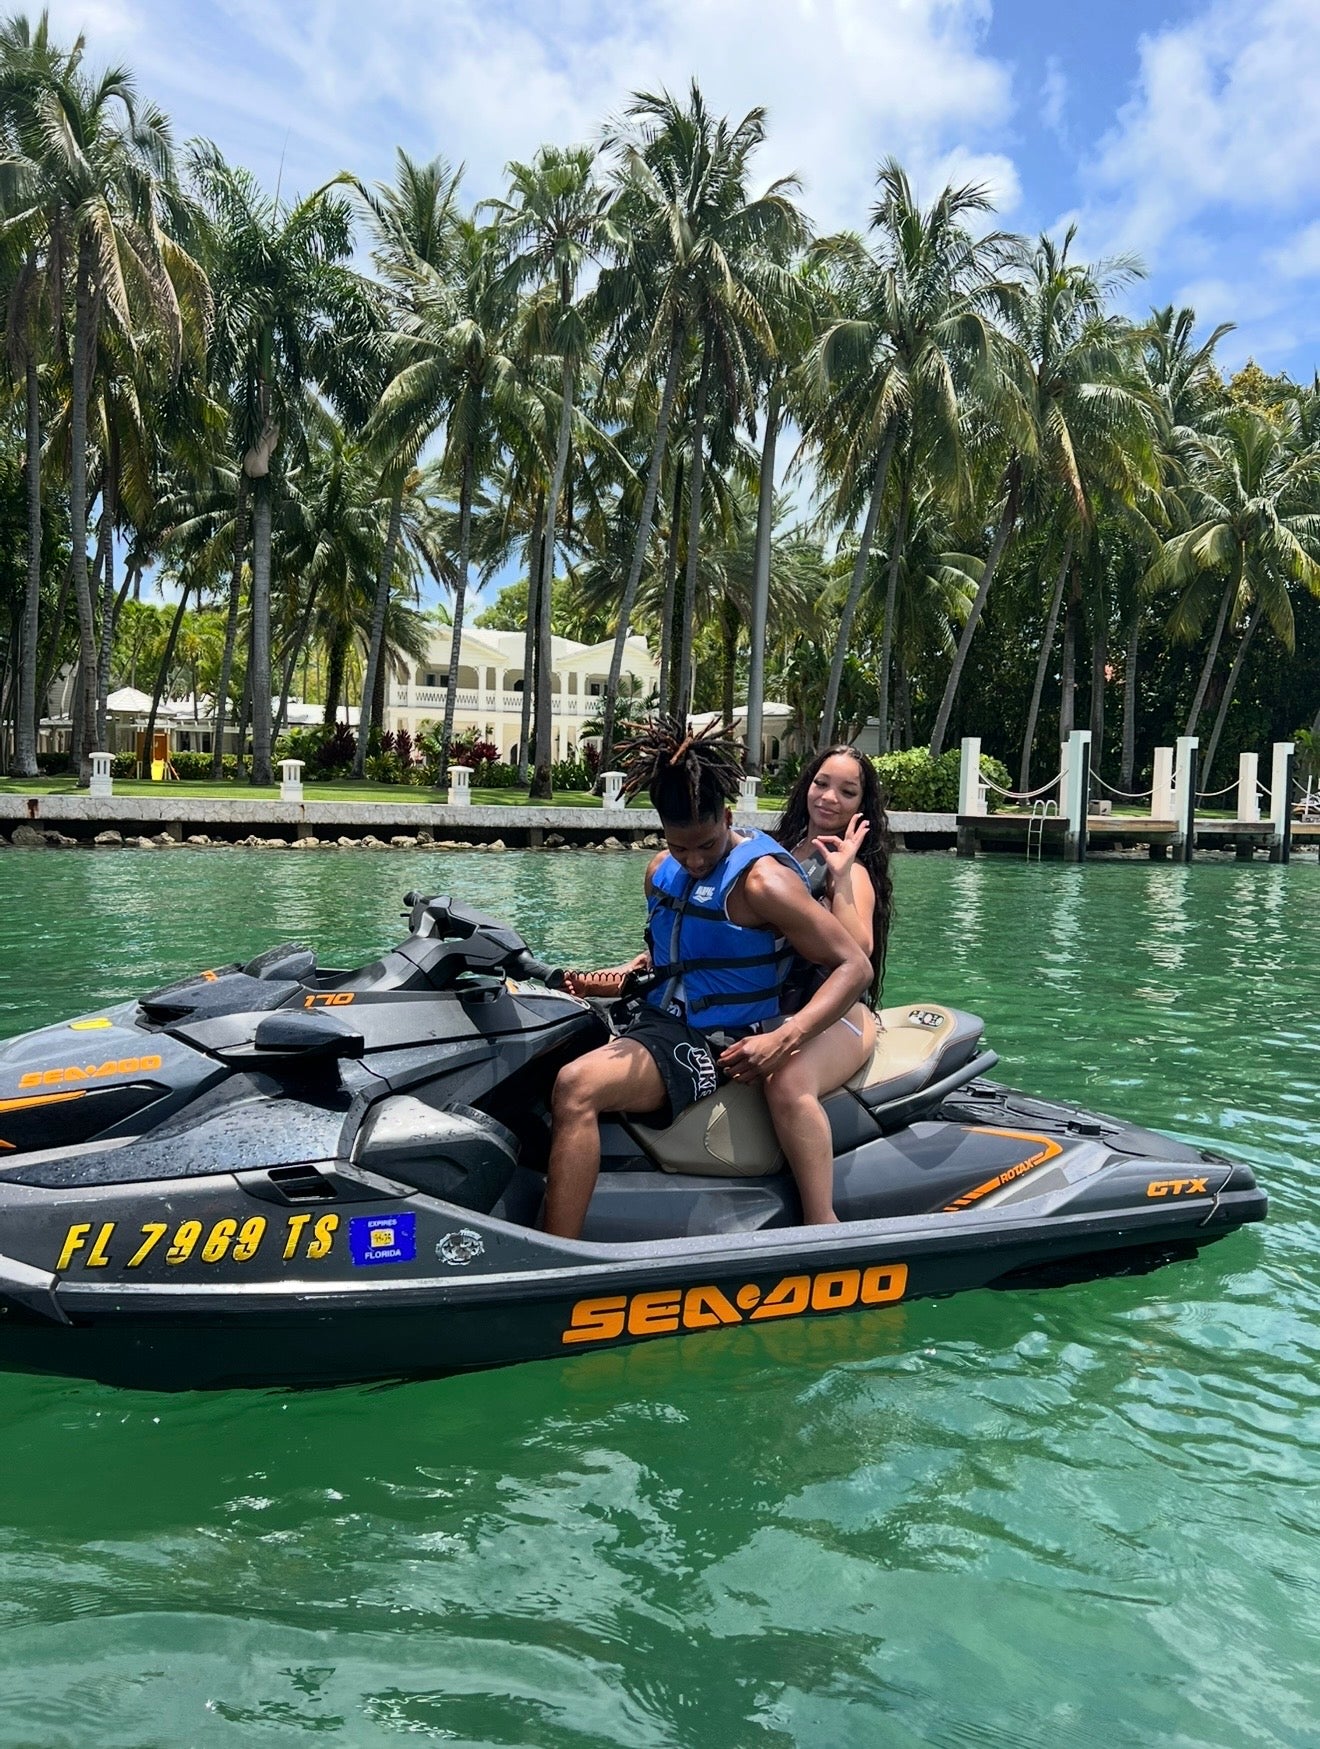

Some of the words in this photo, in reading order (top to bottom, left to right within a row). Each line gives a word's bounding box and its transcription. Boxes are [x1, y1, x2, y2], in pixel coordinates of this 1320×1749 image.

[304, 991, 356, 1008] 170
[1000, 1158, 1034, 1184] ROTAX
[1146, 1177, 1209, 1197] GTX
[367, 1218, 398, 1228] EXPIRES
[56, 1222, 116, 1271] FL
[127, 1216, 268, 1267] 7969
[282, 1213, 339, 1260] TS
[364, 1248, 402, 1260] FLORIDA
